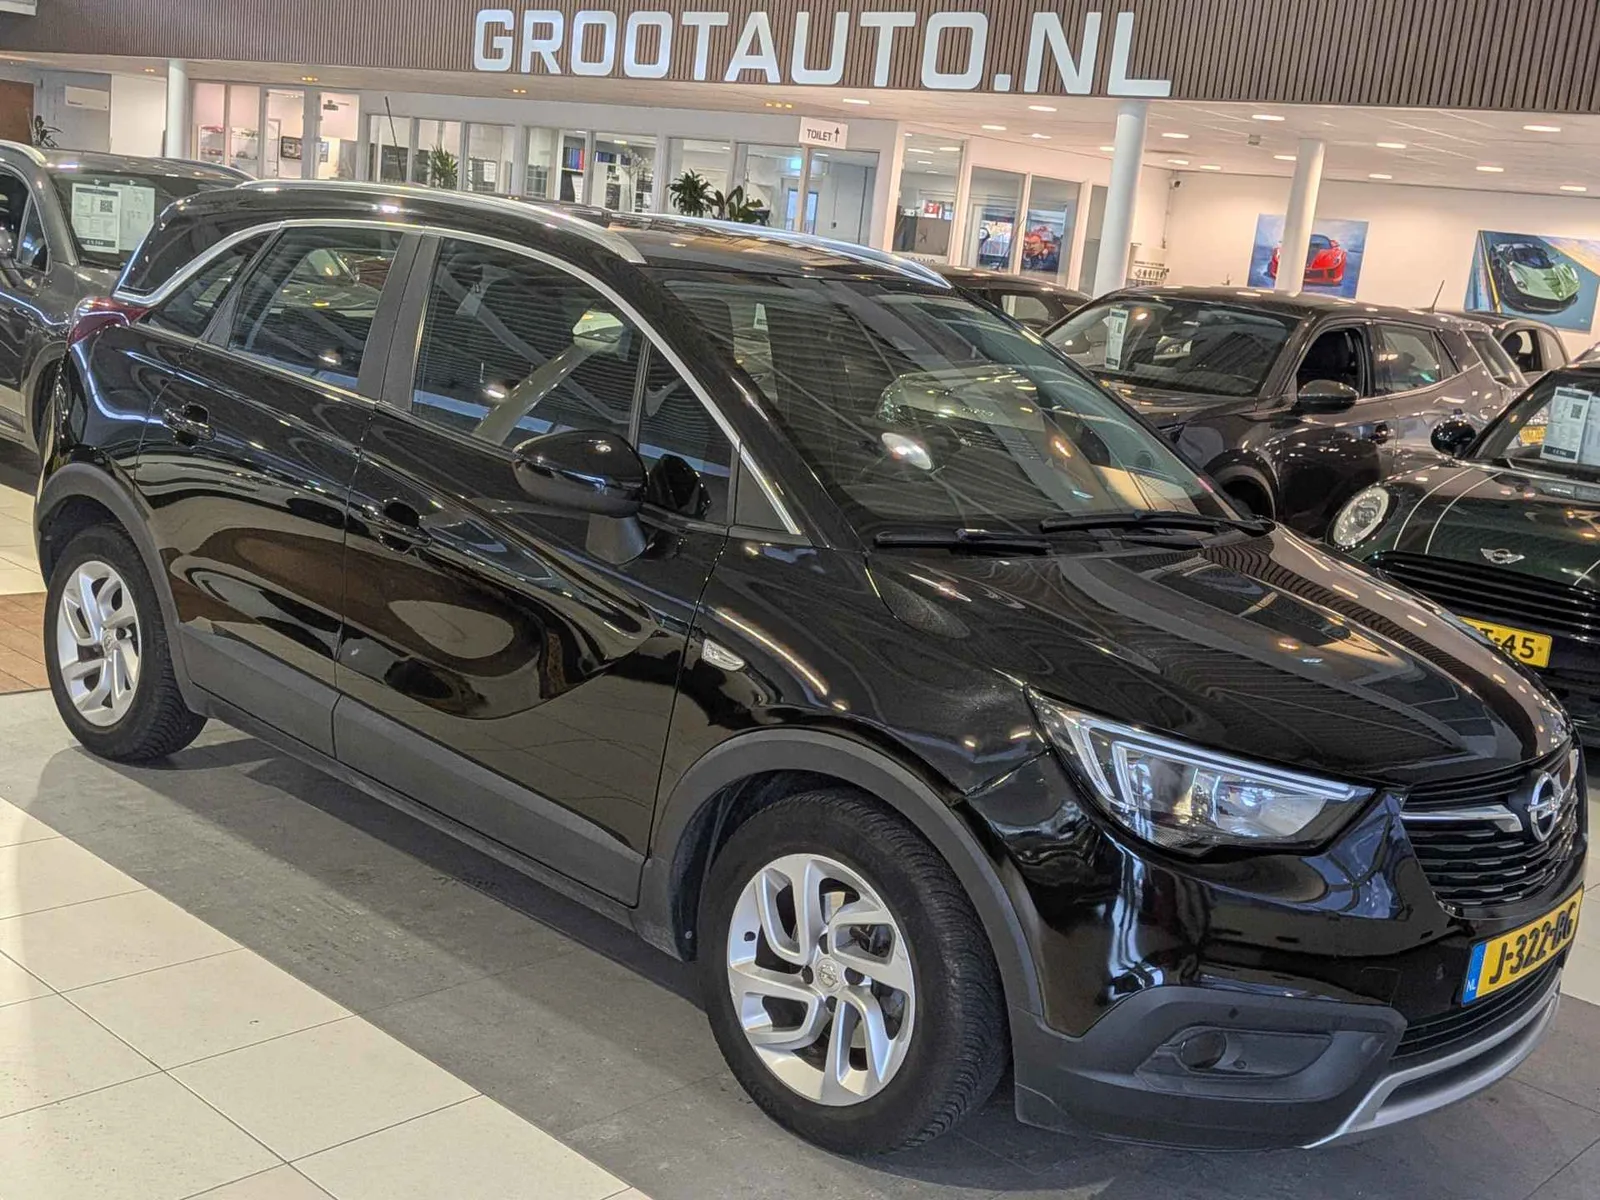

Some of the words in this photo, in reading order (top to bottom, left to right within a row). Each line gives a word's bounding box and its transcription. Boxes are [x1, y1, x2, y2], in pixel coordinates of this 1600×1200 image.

[473, 9, 1172, 97] GROOTAUTO.NL
[807, 128, 833, 141] TOILET
[1466, 979, 1476, 993] NL
